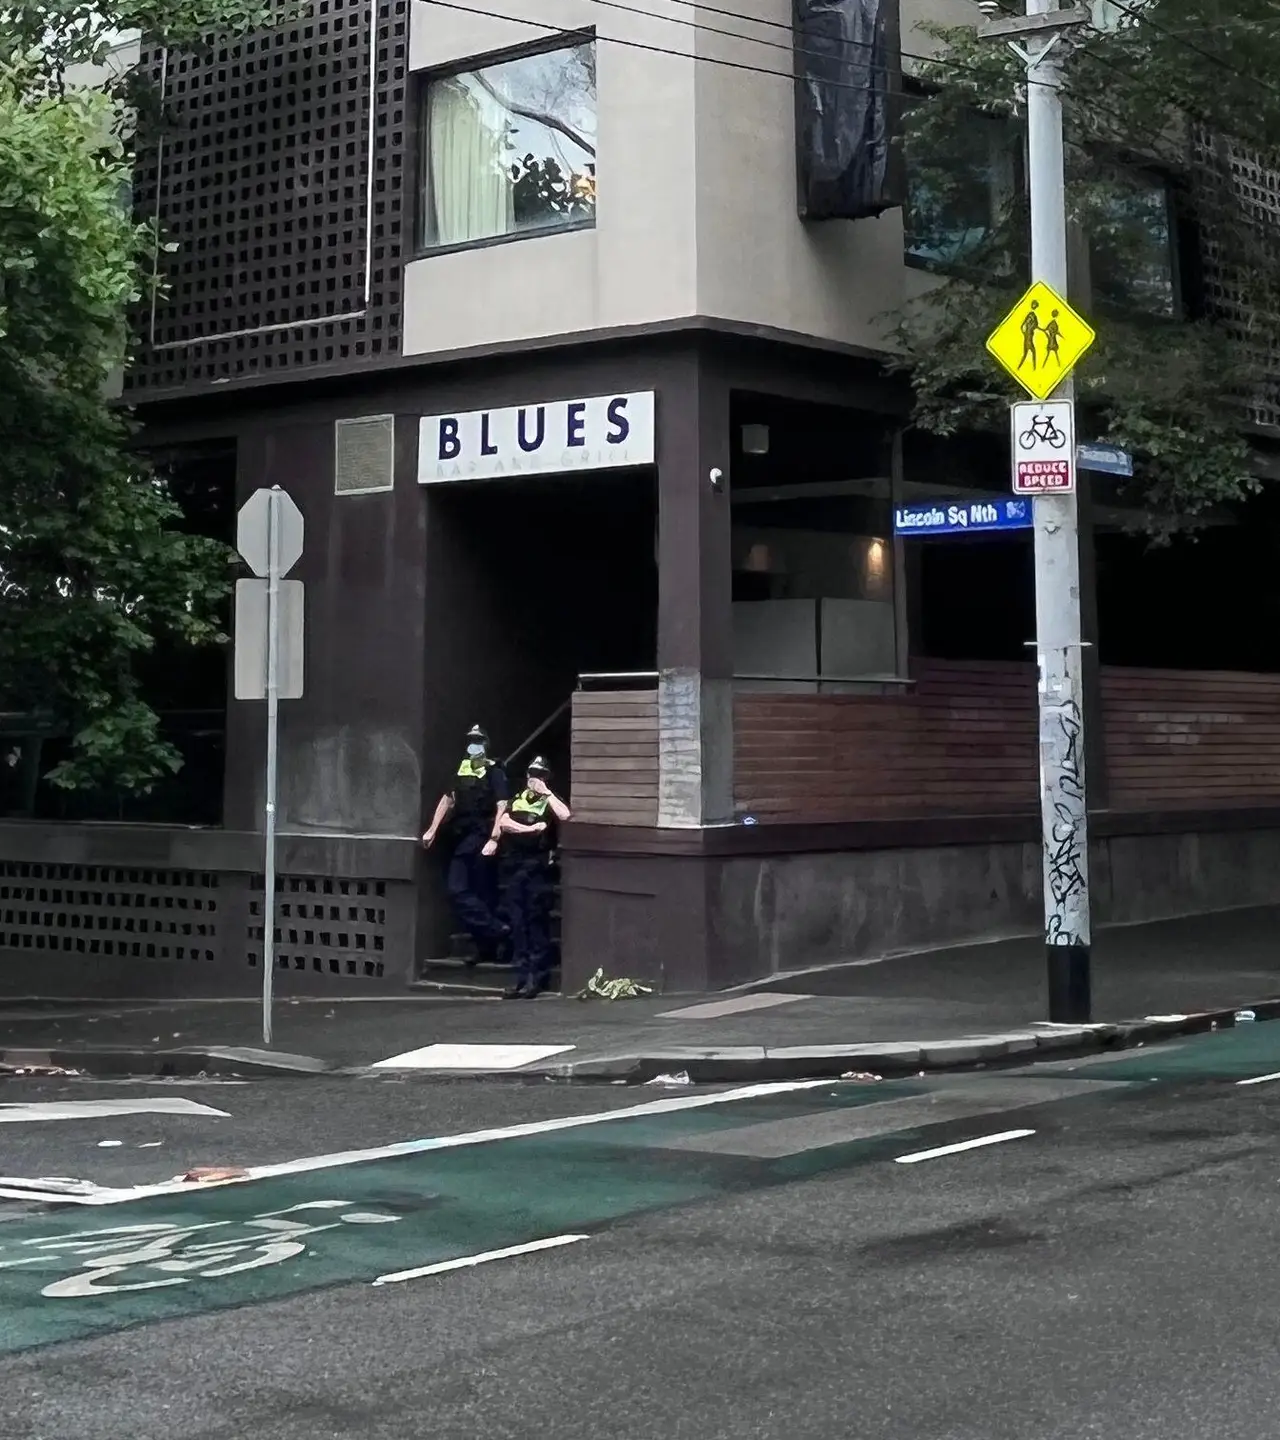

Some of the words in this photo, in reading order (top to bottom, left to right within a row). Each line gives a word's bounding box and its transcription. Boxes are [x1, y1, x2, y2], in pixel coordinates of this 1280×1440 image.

[438, 397, 630, 460] BLUES
[1019, 462, 1067, 474] REDUCE
[1023, 474, 1064, 487] SPEED
[896, 508, 945, 527] Lincoln
[948, 506, 968, 527] Sq
[970, 504, 998, 523] Nth
